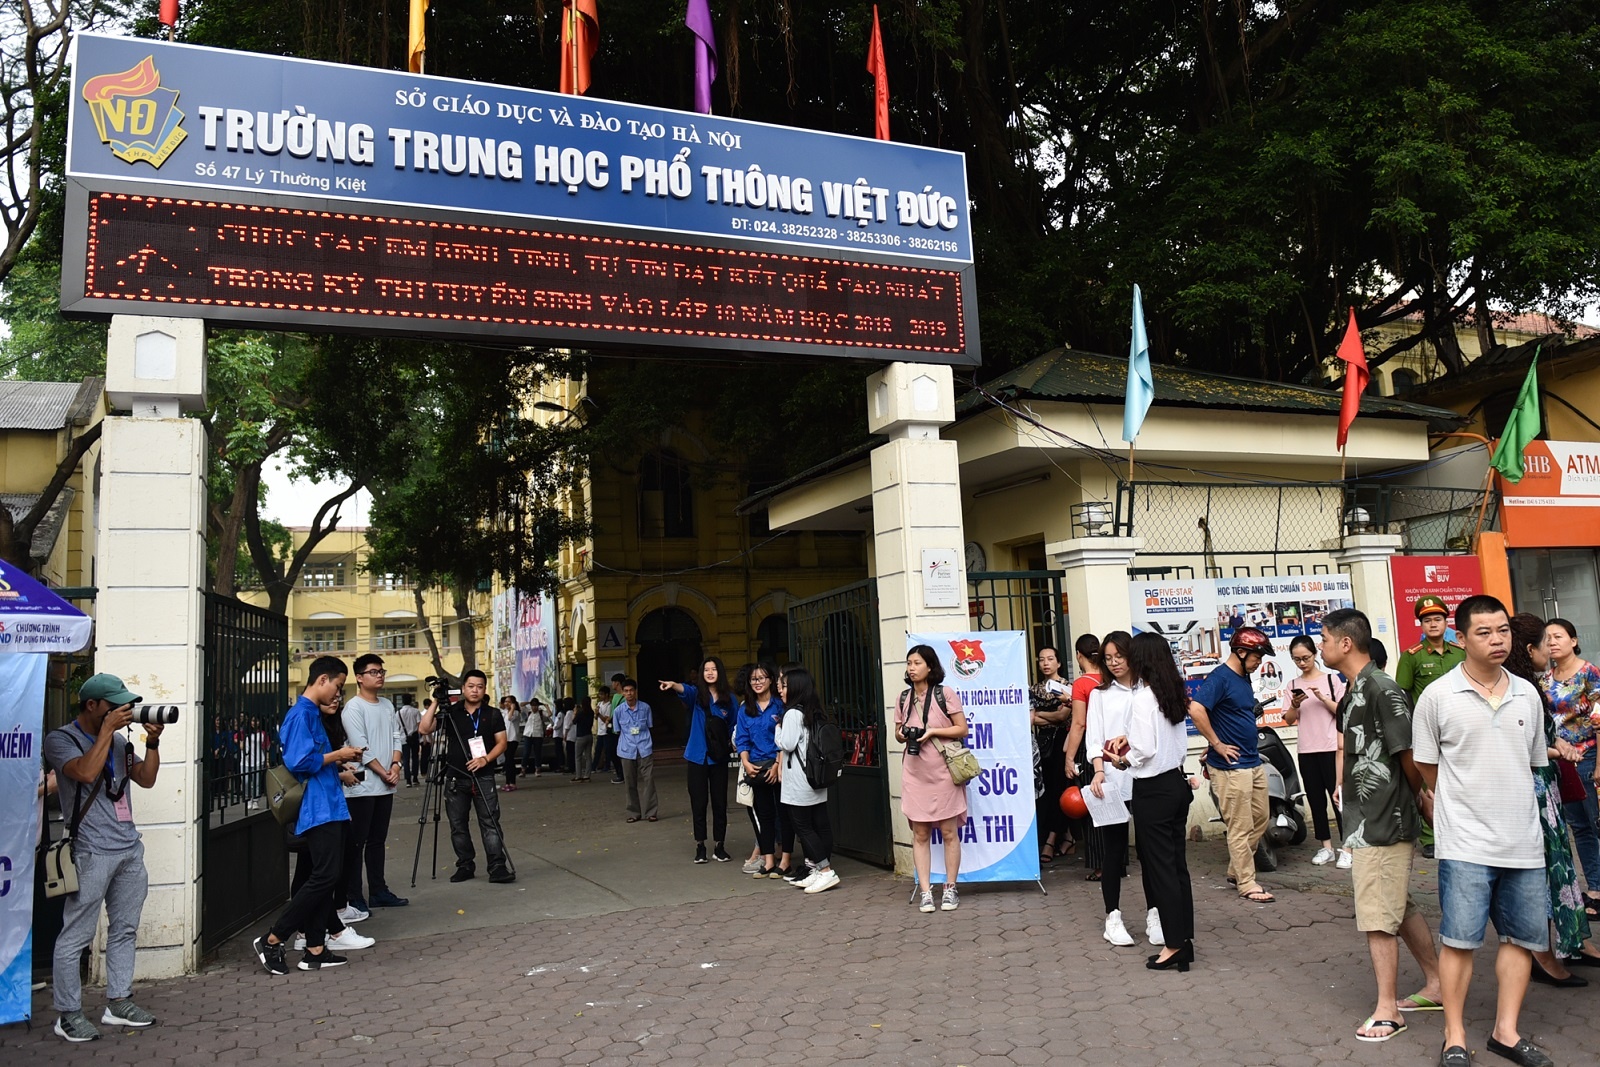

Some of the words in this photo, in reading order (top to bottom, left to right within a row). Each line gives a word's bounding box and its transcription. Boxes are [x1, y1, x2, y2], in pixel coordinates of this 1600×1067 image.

[395, 87, 427, 107] SỞ
[433, 95, 490, 115] GIÁO
[497, 102, 543, 124] DỤC
[548, 106, 575, 127] VÀ
[580, 111, 621, 132] ĐÀO
[627, 119, 665, 141] TẠO
[672, 124, 702, 144] HÀ
[708, 131, 742, 151] NỘI
[194, 161, 218, 177] Số
[221, 165, 241, 180] 47
[245, 168, 264, 185] Lý
[269, 168, 330, 191] Thường
[335, 174, 367, 192] Kiệt
[198, 105, 375, 166] TRƯỜNG
[388, 127, 523, 181] TRUNG
[534, 144, 610, 194] HỌC
[620, 146, 692, 199] PHỔ
[701, 163, 814, 215] THÔNG
[821, 177, 889, 227] VIỆT
[897, 185, 959, 231] ĐỨC
[846, 230, 901, 247] 38253306
[908, 236, 958, 253] 38262156
[837, 277, 880, 295] CAO
[207, 266, 314, 291] TRONG
[374, 278, 427, 300] THI
[533, 290, 592, 311] SINH
[600, 292, 653, 315] VÀO
[715, 304, 736, 321] 10
[799, 310, 849, 333] HỌC
[909, 319, 947, 336] 2019
[1566, 454, 1600, 475] ATM
[1160, 596, 1194, 606] ENGLISH
[1217, 586, 1230, 598] HỌC
[1231, 583, 1250, 596] TIẾNG
[1251, 585, 1264, 595] ANH
[1301, 581, 1307, 593] 5
[1308, 581, 1323, 592] SAO
[601, 625, 623, 648] A
[971, 686, 997, 706] HOÀN
[999, 684, 1023, 705] KIẾM
[1264, 712, 1283, 724] 0033
[978, 763, 1018, 797] SỨC
[982, 815, 1015, 843] THI
